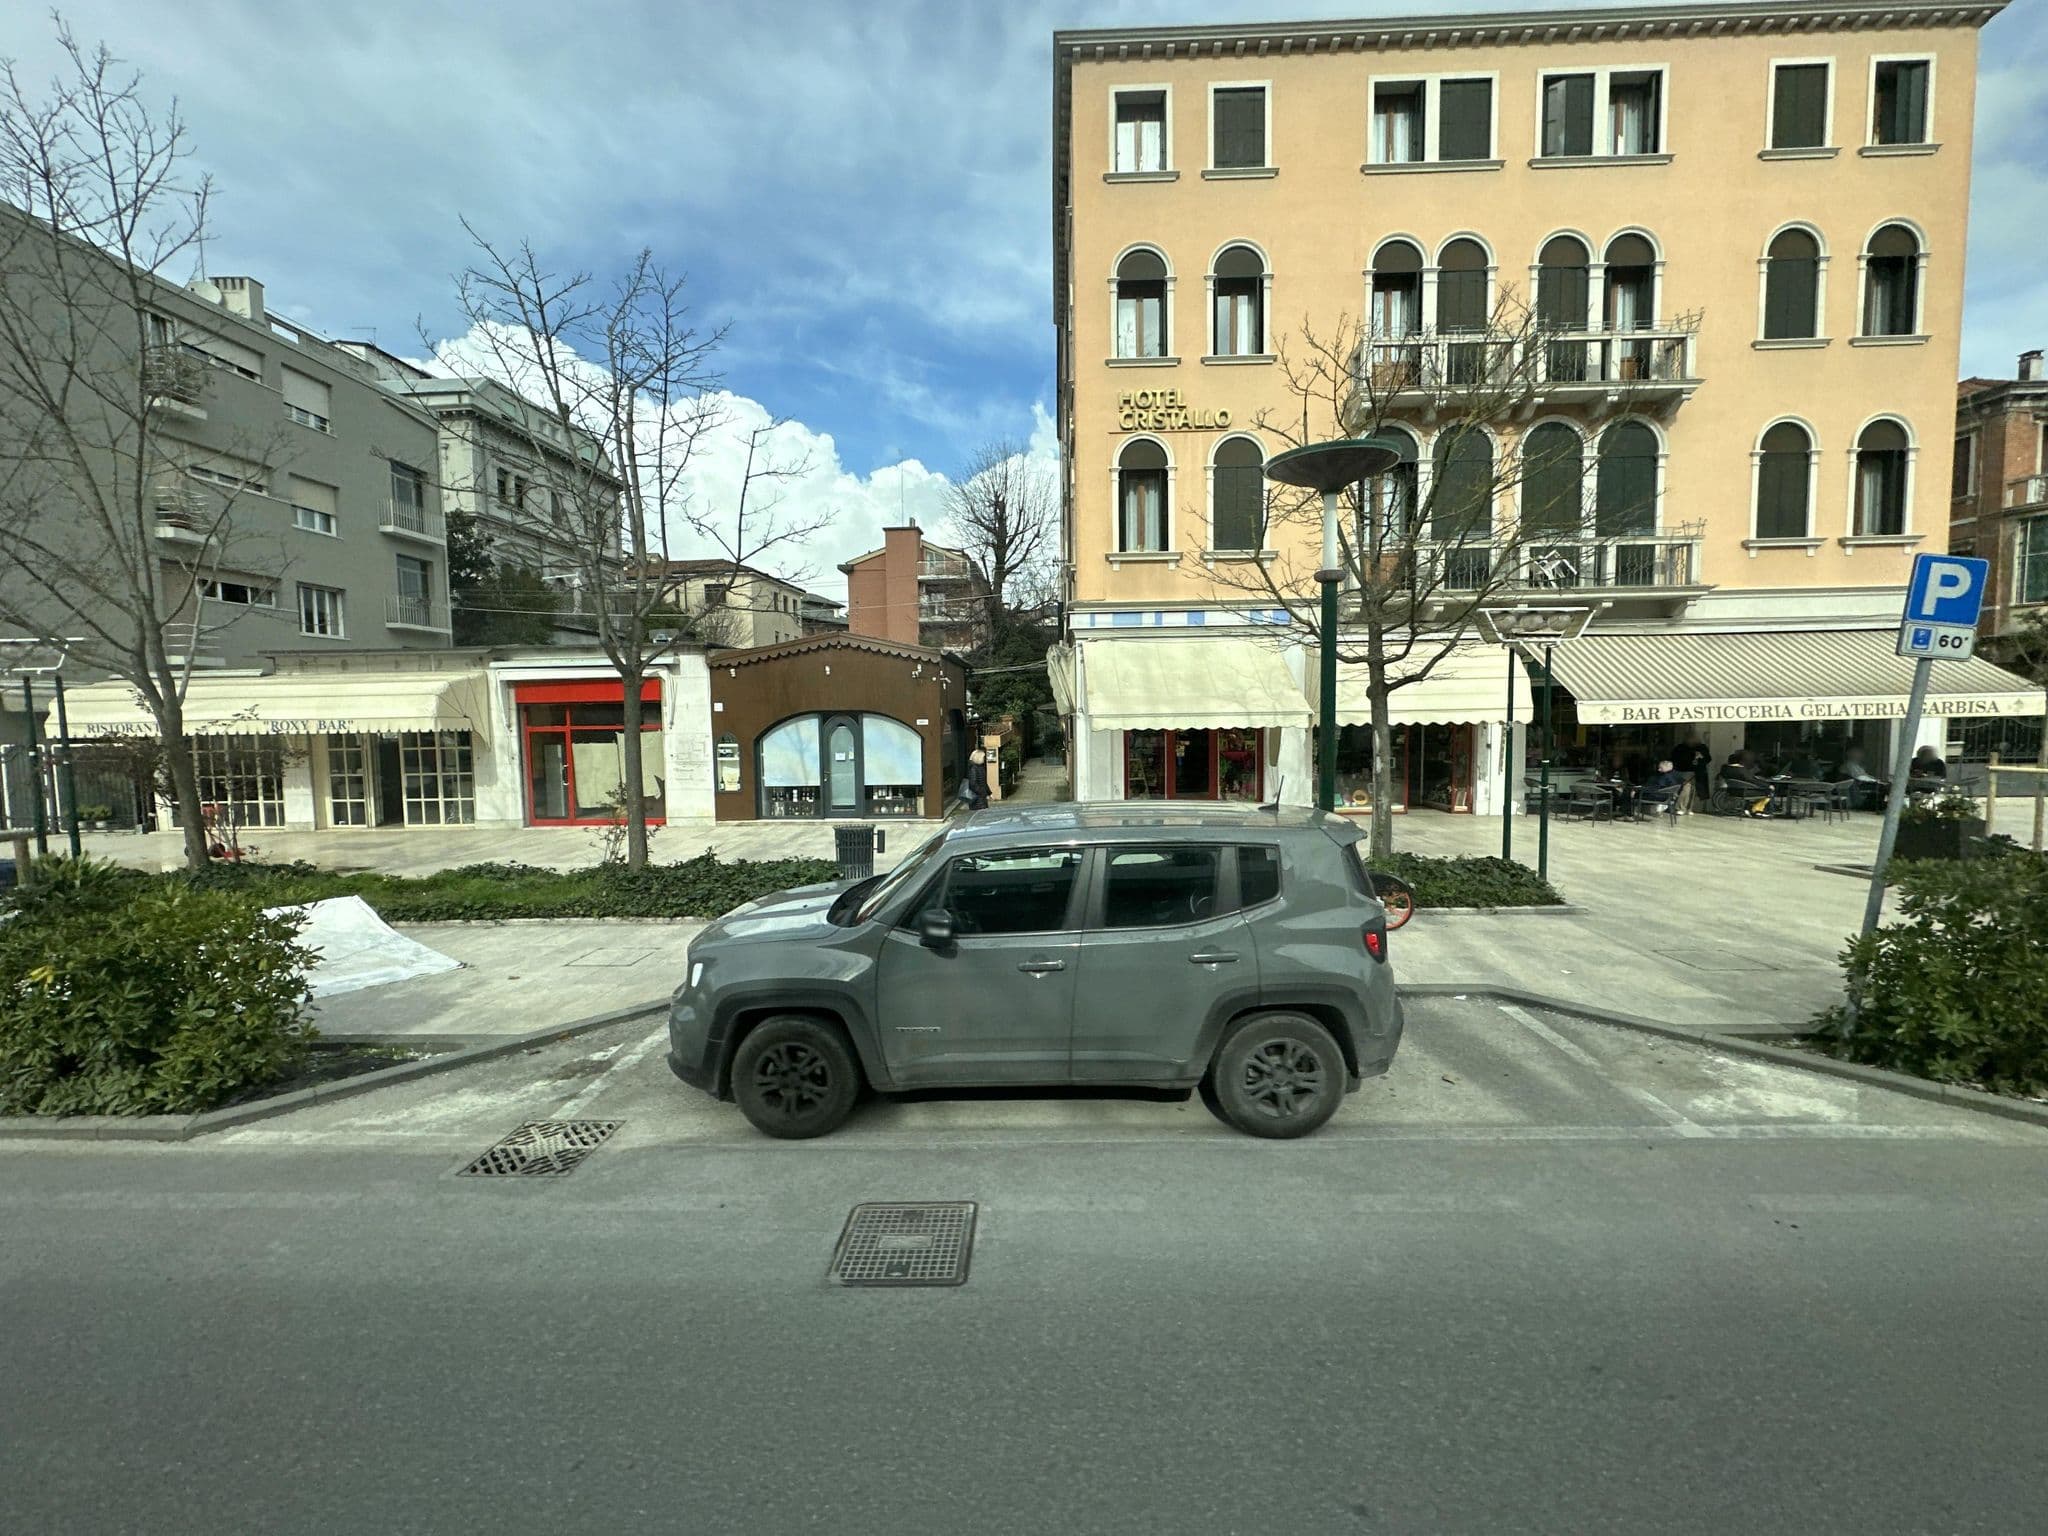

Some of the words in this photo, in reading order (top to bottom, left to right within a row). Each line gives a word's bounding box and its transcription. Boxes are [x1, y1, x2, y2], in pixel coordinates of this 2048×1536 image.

[1119, 388, 1187, 409] HOTEL
[1119, 408, 1232, 430] CRISTALLO
[1921, 561, 1972, 616] P
[1622, 707, 1661, 721] BAR
[1668, 704, 1793, 720] PASTICCERIA
[1800, 702, 1908, 717] GELATERIA
[87, 722, 161, 734] RISTORANT
